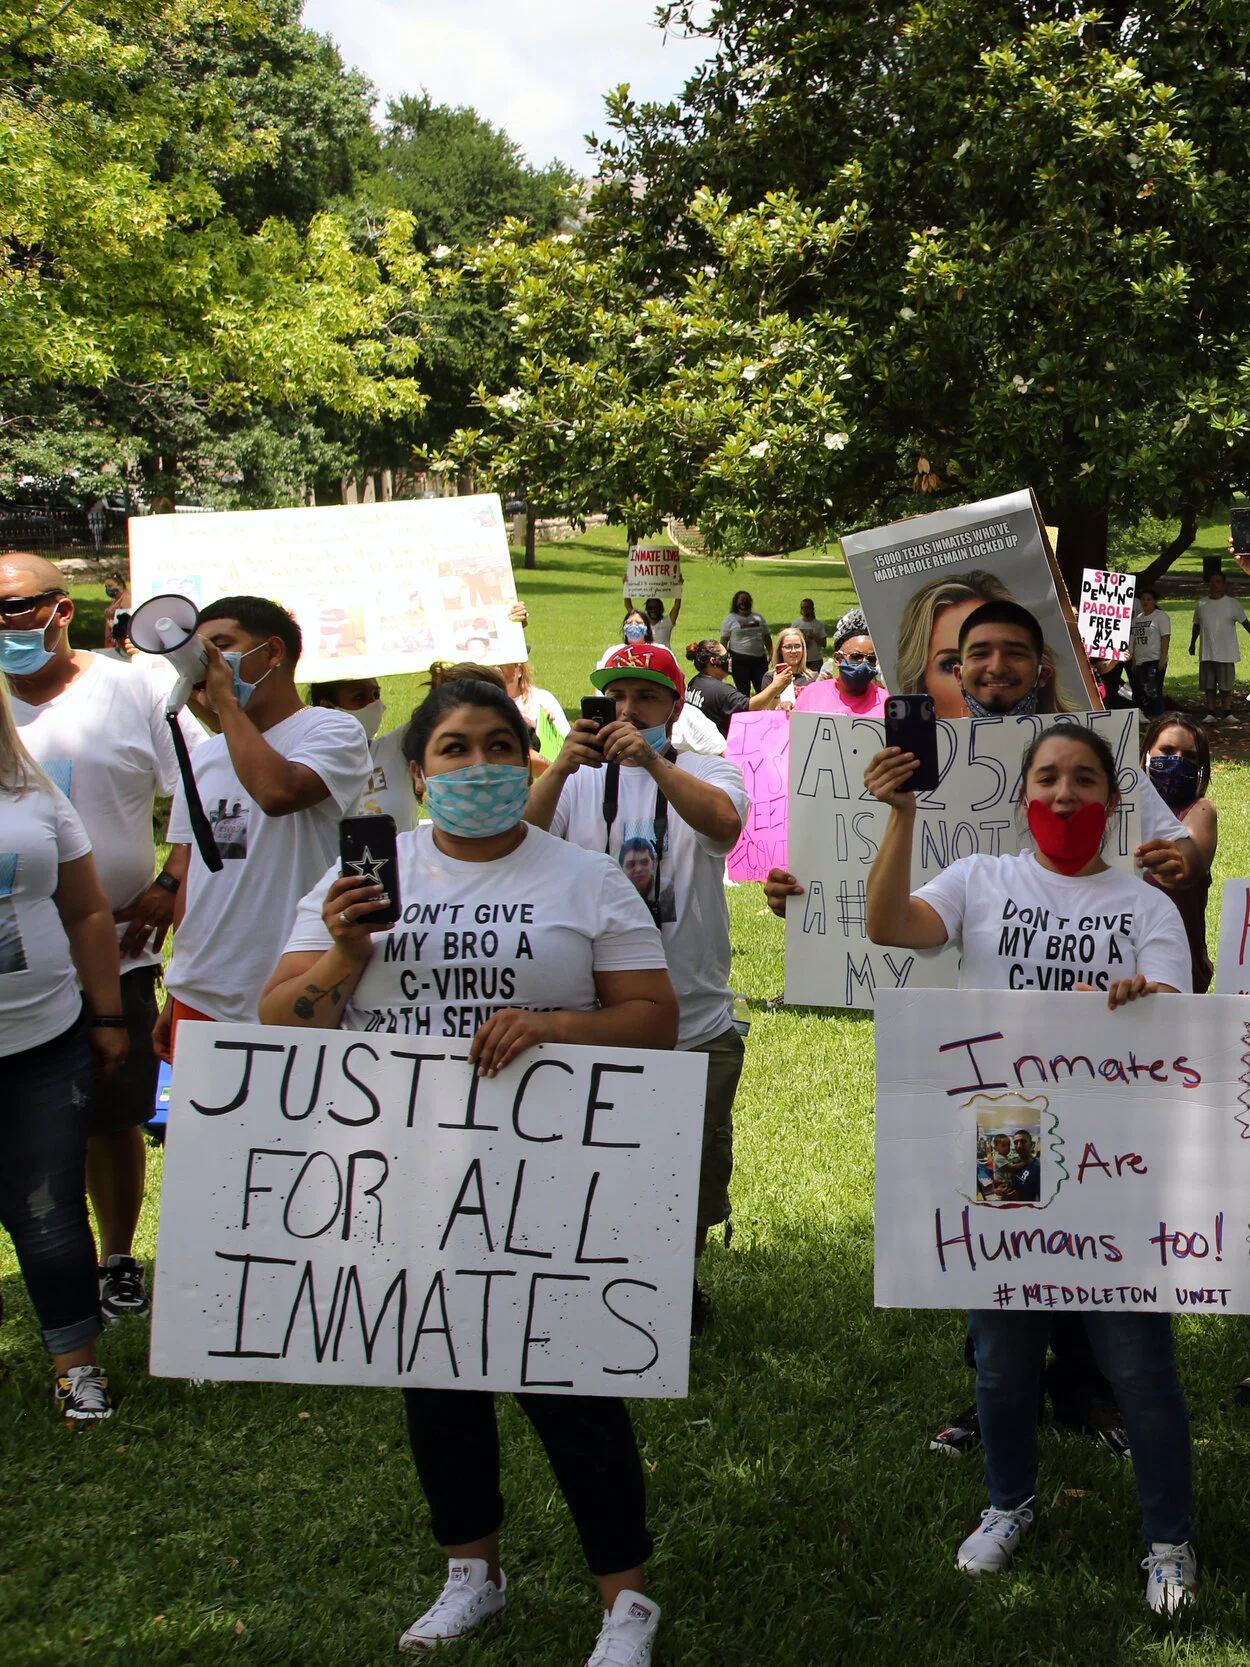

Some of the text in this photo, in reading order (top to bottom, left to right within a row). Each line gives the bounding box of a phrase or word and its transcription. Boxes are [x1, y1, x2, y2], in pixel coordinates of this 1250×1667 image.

[630, 550, 660, 562] INMATE
[873, 535, 1018, 583] MADE PAROLE REMAIN LOCKED UP
[874, 522, 1010, 568] 15000 TEXAS INMATES WHO'VE
[1083, 581, 1134, 604] DENYING
[1095, 571, 1126, 586] STOP
[1083, 602, 1130, 618] PAROLE
[1089, 616, 1120, 630] FREE
[1082, 638, 1128, 659] USBAND
[1095, 628, 1112, 640] MY
[922, 820, 1010, 868] NOT
[475, 904, 534, 924] GIVE
[1078, 914, 1133, 936] GIVE
[384, 930, 534, 962] MY BRO A
[998, 926, 1122, 964] MY BRO A
[400, 967, 516, 1001] C-VIRUS
[846, 952, 914, 1005] MY
[364, 1006, 430, 1036] DEATH
[938, 1031, 1202, 1096] Inmates
[190, 1040, 644, 1148] JUSTICE
[1077, 1142, 1148, 1184] Are
[242, 1148, 628, 1264] FOR ALL
[935, 1206, 1224, 1272] Humans too!
[1176, 1287, 1232, 1306] UNIT
[208, 1251, 659, 1388] INMATES
